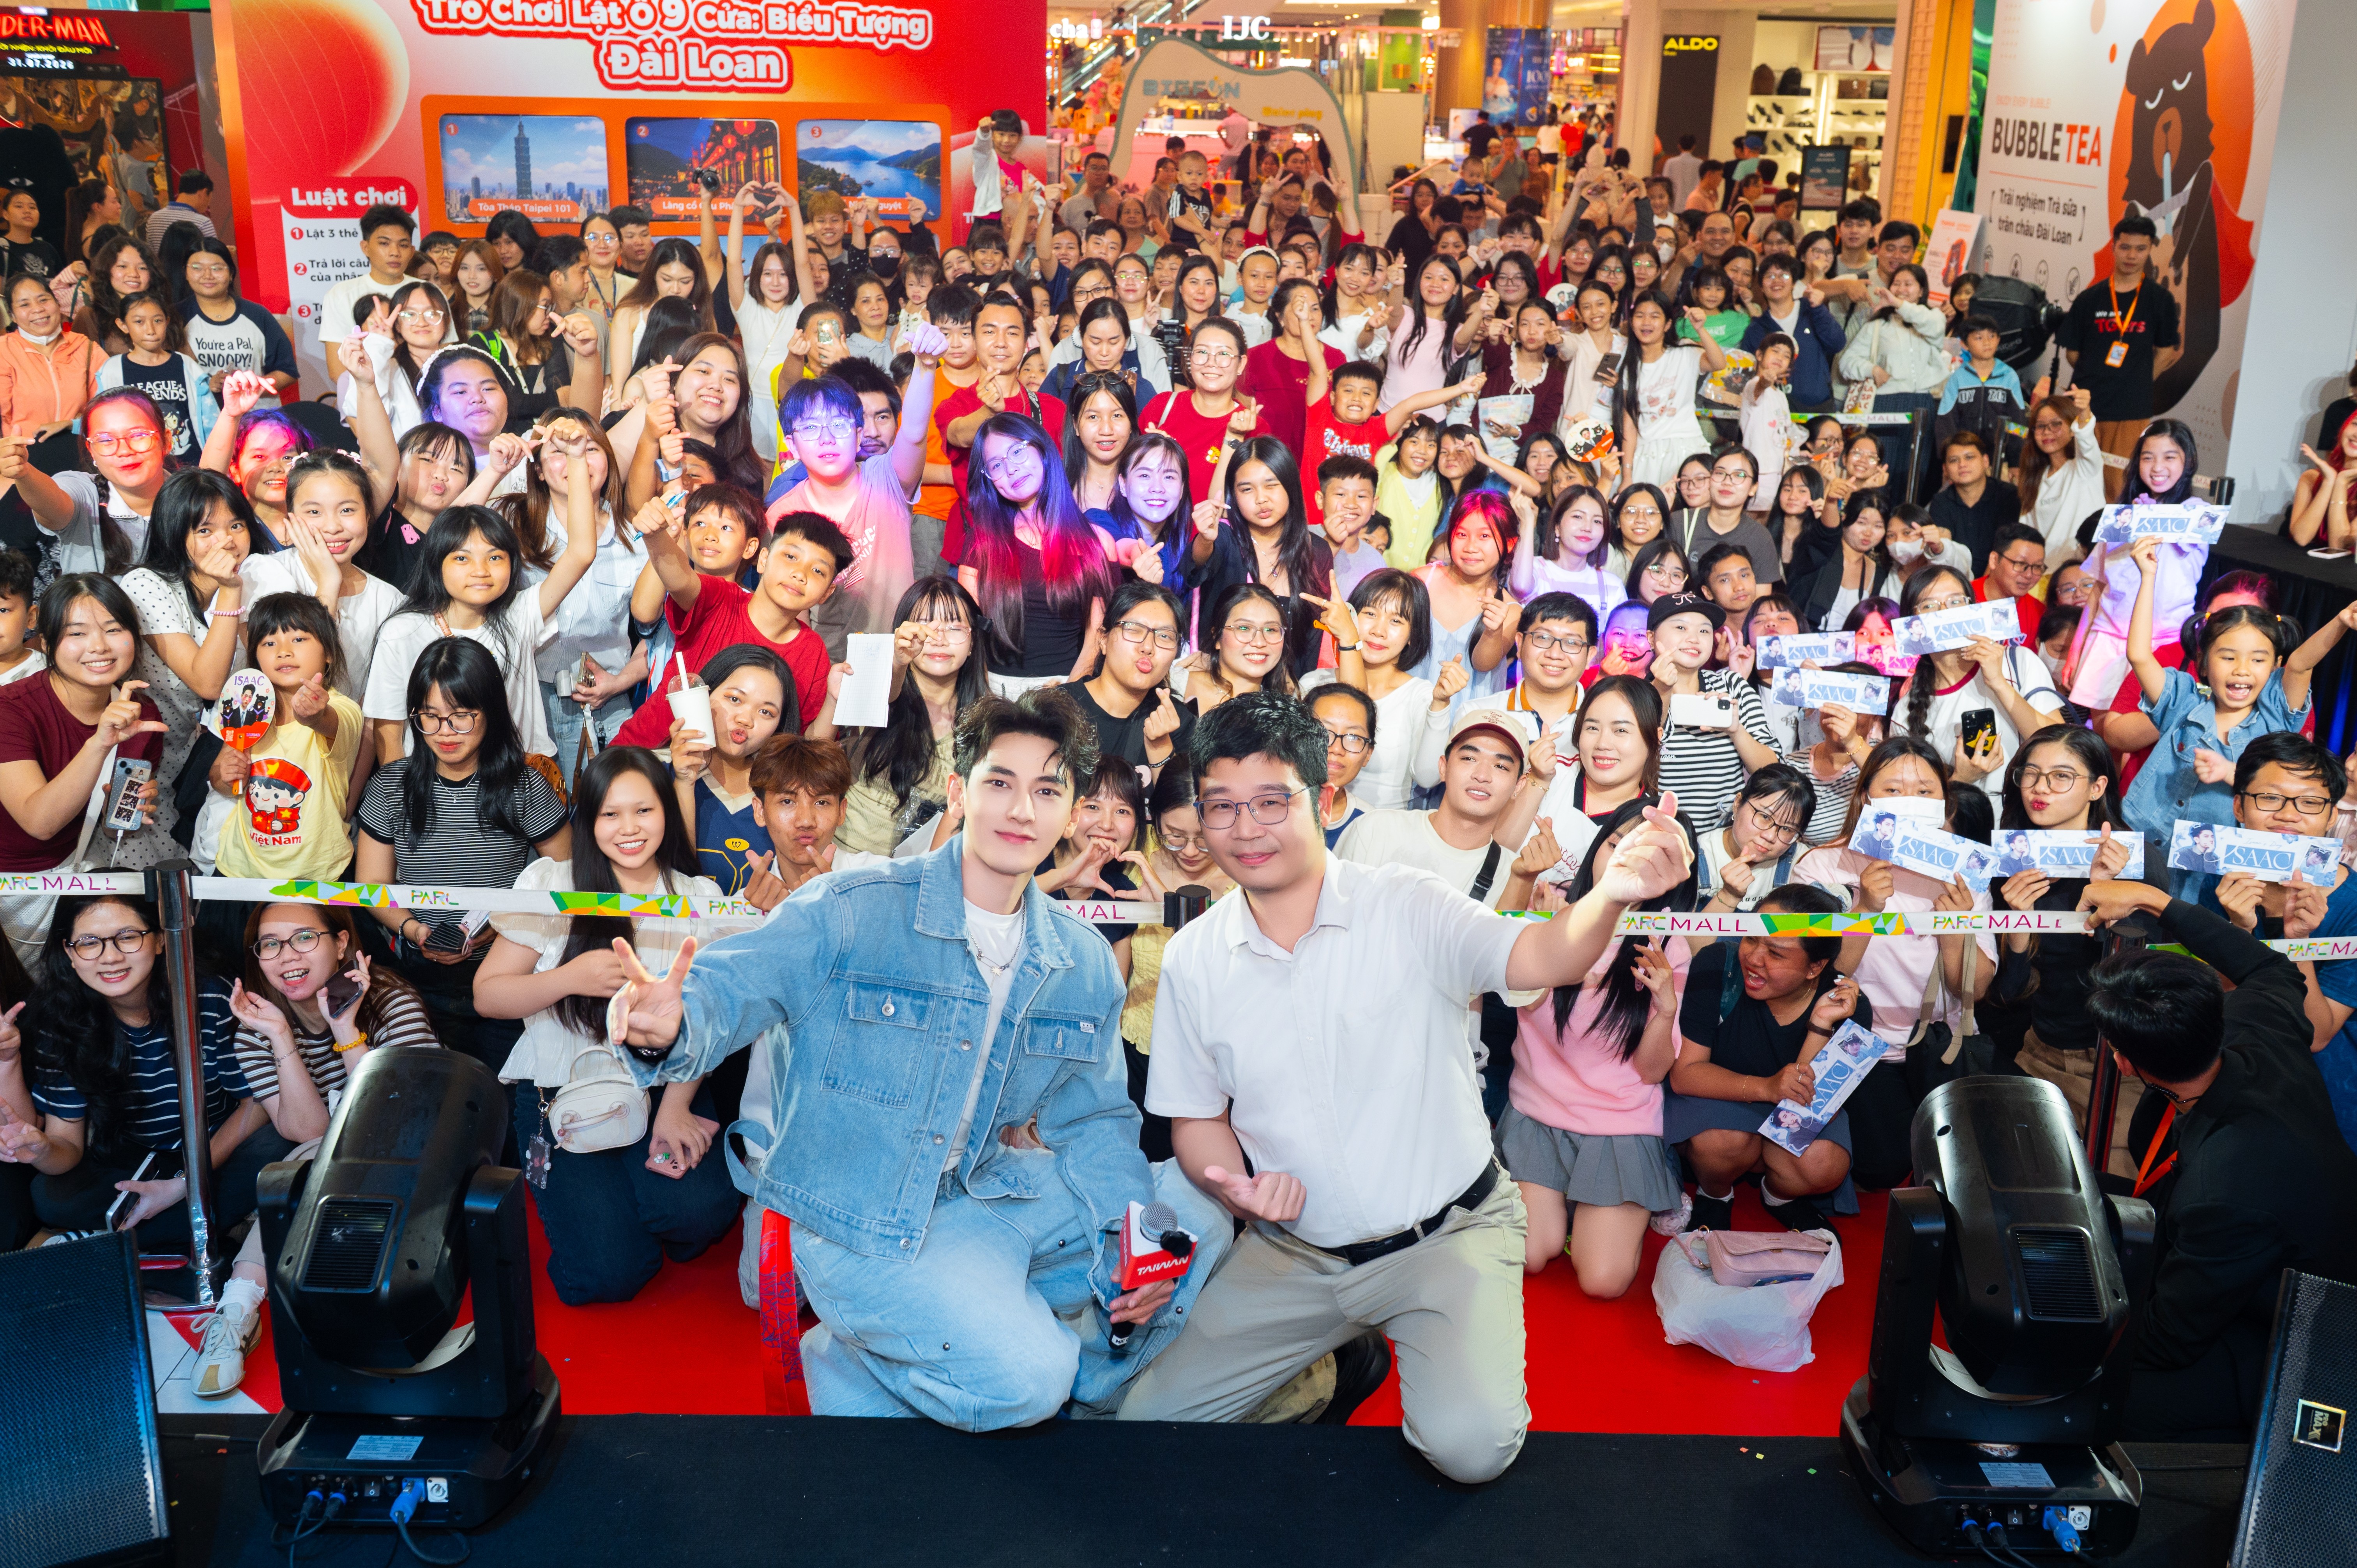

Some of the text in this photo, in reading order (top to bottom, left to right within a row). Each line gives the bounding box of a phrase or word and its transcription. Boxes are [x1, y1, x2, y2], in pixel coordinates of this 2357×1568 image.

[572, 0, 622, 32] Lật
[661, 0, 681, 28] 9
[696, 2, 760, 30] Cửa:
[767, 4, 831, 33] Biểu
[838, 10, 925, 42] Tượng
[1050, 18, 1088, 38] cha
[1664, 37, 1718, 51] ALDO
[608, 40, 780, 79] Đài Loan
[1992, 117, 2102, 167] BUBBLE TEA
[291, 185, 406, 211] Luật chơi
[662, 200, 684, 211] Làng
[2000, 188, 2014, 205] Trải
[2015, 191, 2045, 214] nghiệm
[2048, 196, 2060, 214] Trà
[478, 202, 495, 211] Tòa
[523, 203, 552, 214] Taipei
[555, 204, 571, 213] 101
[306, 229, 325, 240] Lật
[328, 229, 335, 238] 3
[339, 228, 358, 238] thẻ
[1998, 215, 2072, 245] trân châu Đài Loan
[309, 259, 328, 268] Trả
[331, 258, 345, 268] lời
[349, 258, 370, 268] câu
[310, 272, 331, 281] của
[195, 337, 253, 351] You're a Pal,
[198, 353, 252, 367] SNOOPY!
[131, 380, 178, 391] EAGUE
[234, 675, 265, 686] ISAAC
[249, 830, 302, 847] Việt Nam
[0, 876, 117, 890] ARC MALL
[411, 890, 459, 906] PARC
[709, 900, 756, 915] PARC
[1671, 917, 1748, 932] MALL
[1138, 1255, 1189, 1276] TAIWAN
[2308, 1410, 2323, 1441] MAX
